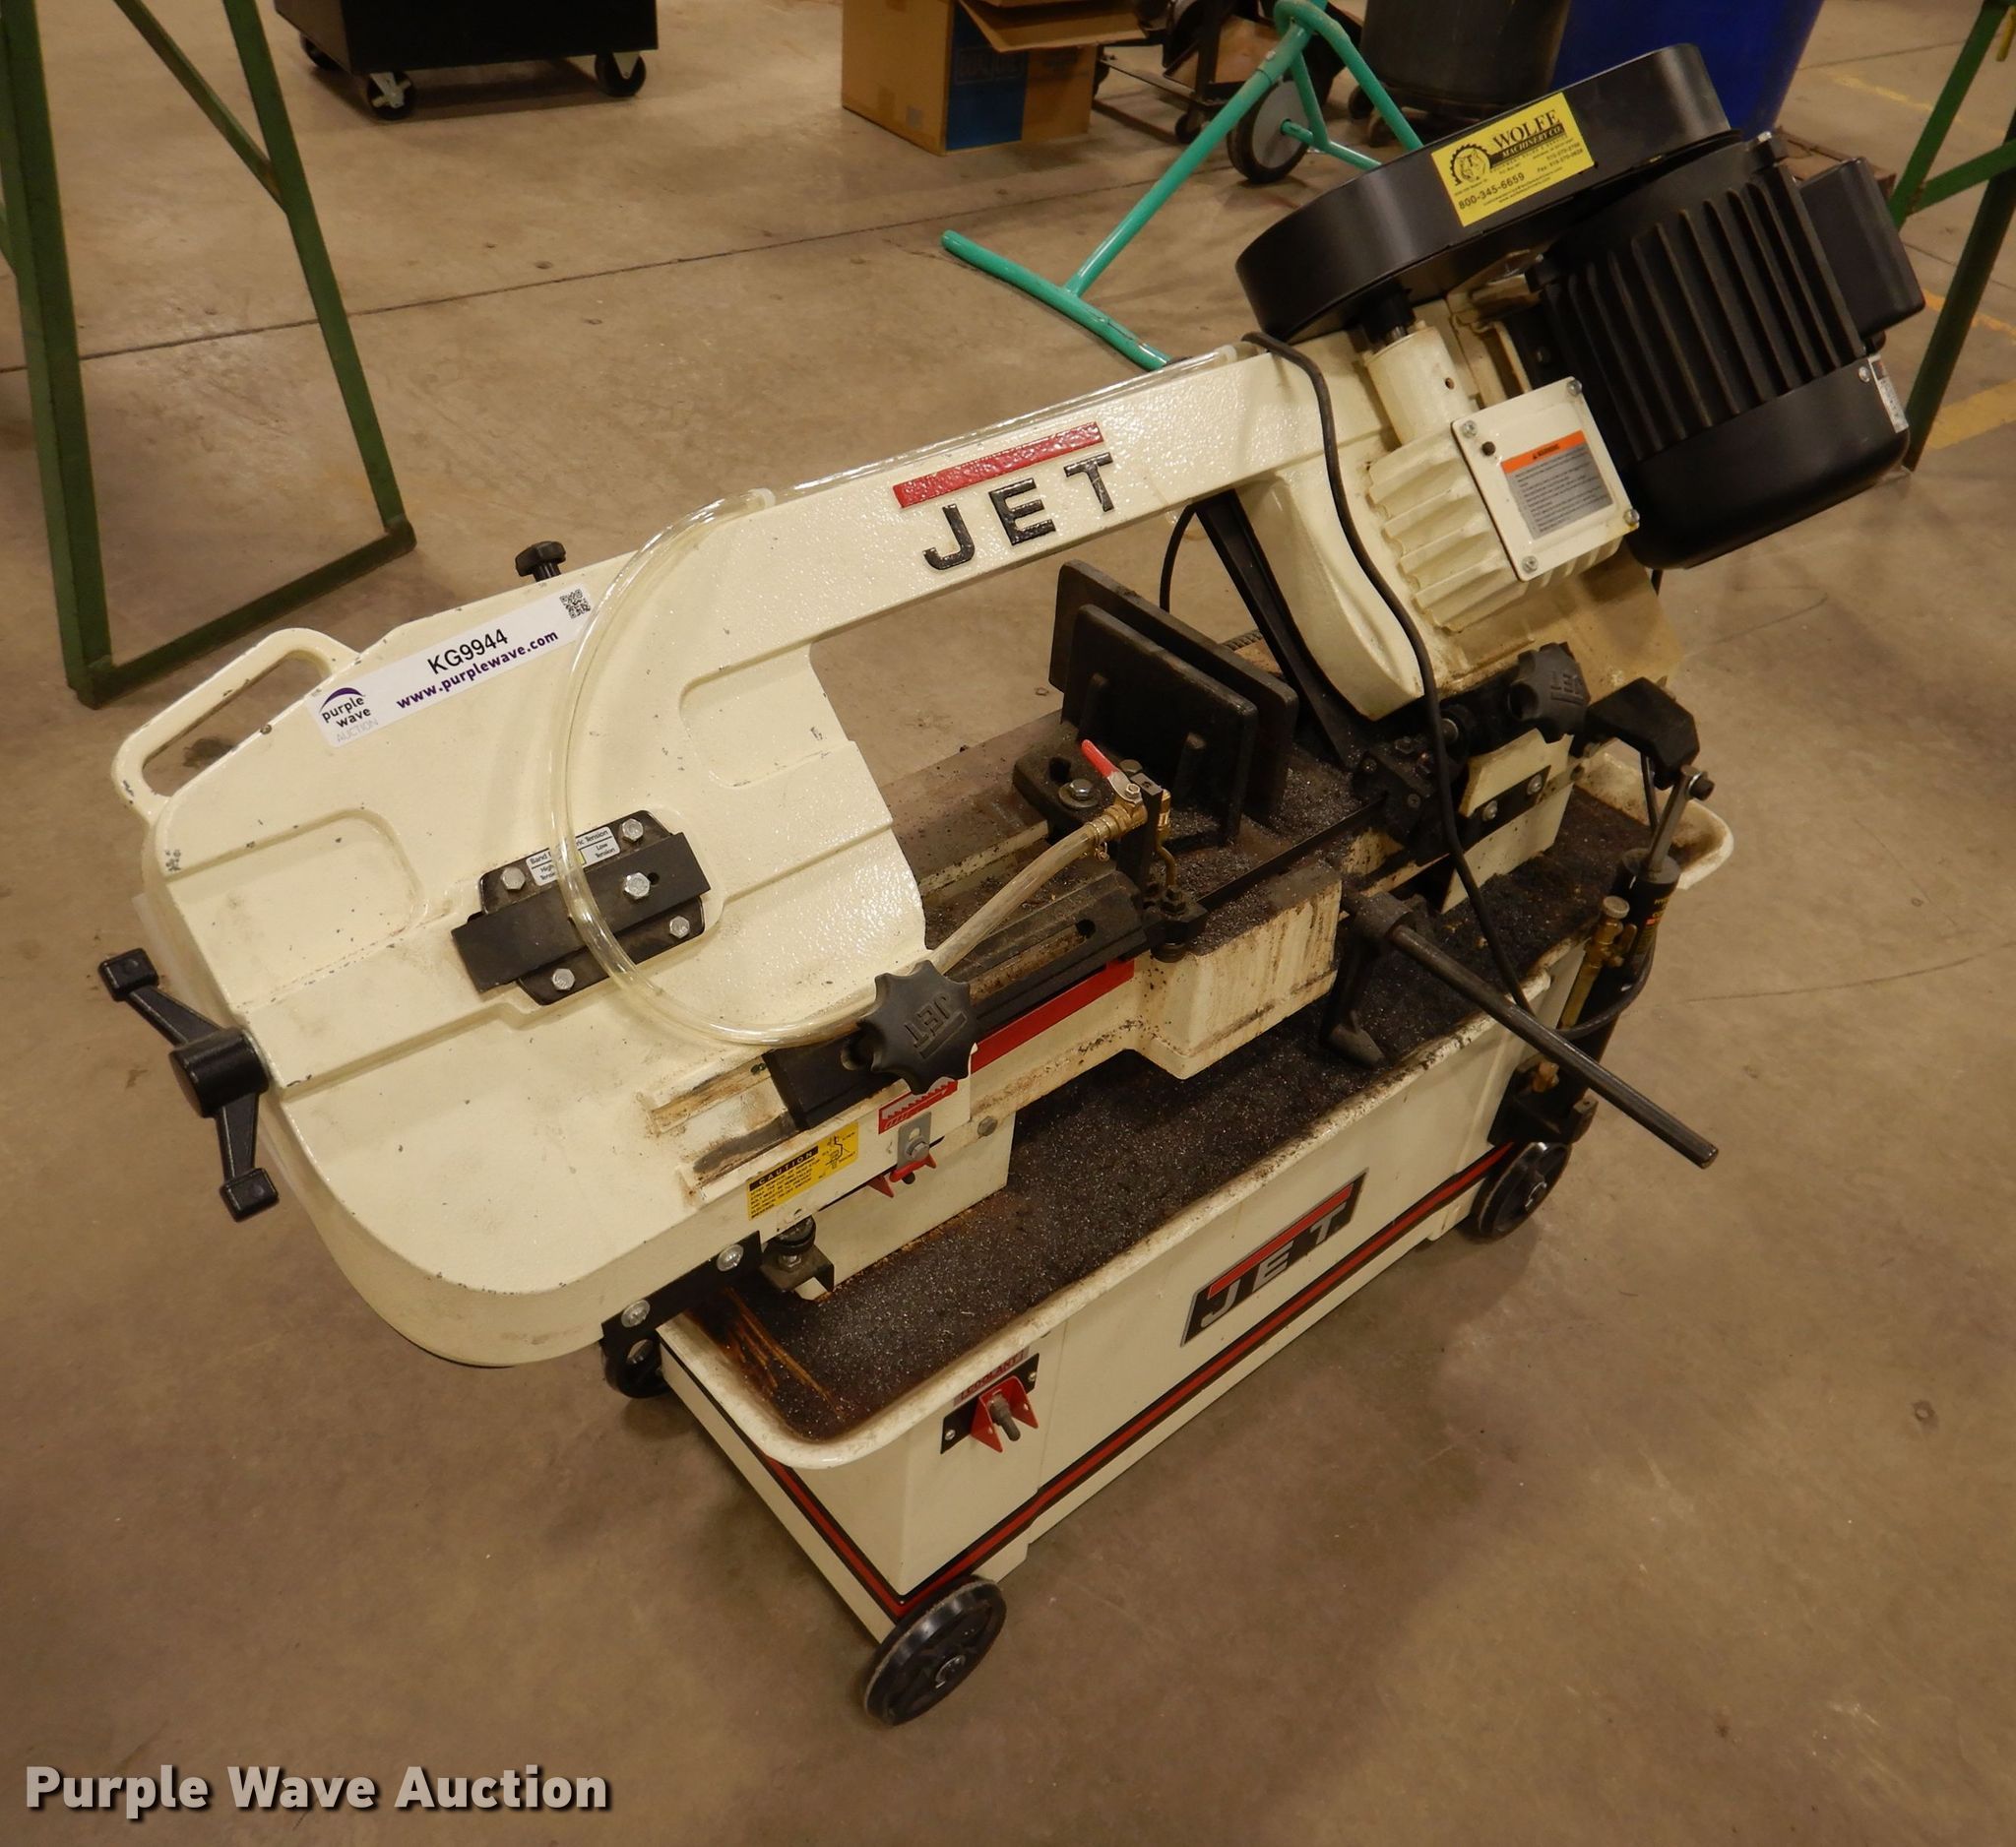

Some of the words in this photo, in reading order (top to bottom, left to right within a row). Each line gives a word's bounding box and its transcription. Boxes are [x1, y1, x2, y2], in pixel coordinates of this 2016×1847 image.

[1492, 109, 1560, 150] WOLFE
[1459, 171, 1526, 210] 800-345-6659
[922, 451, 1115, 571] JET
[396, 630, 559, 709] www.purplewave.com
[427, 628, 509, 675] KG9944
[321, 694, 365, 724] purple
[336, 706, 372, 729] wave
[336, 717, 379, 743] AUCTION
[585, 829, 609, 843] Tension
[904, 991, 953, 1050] JET
[758, 1151, 813, 1185] CAUTION
[1200, 1201, 1348, 1328] JET
